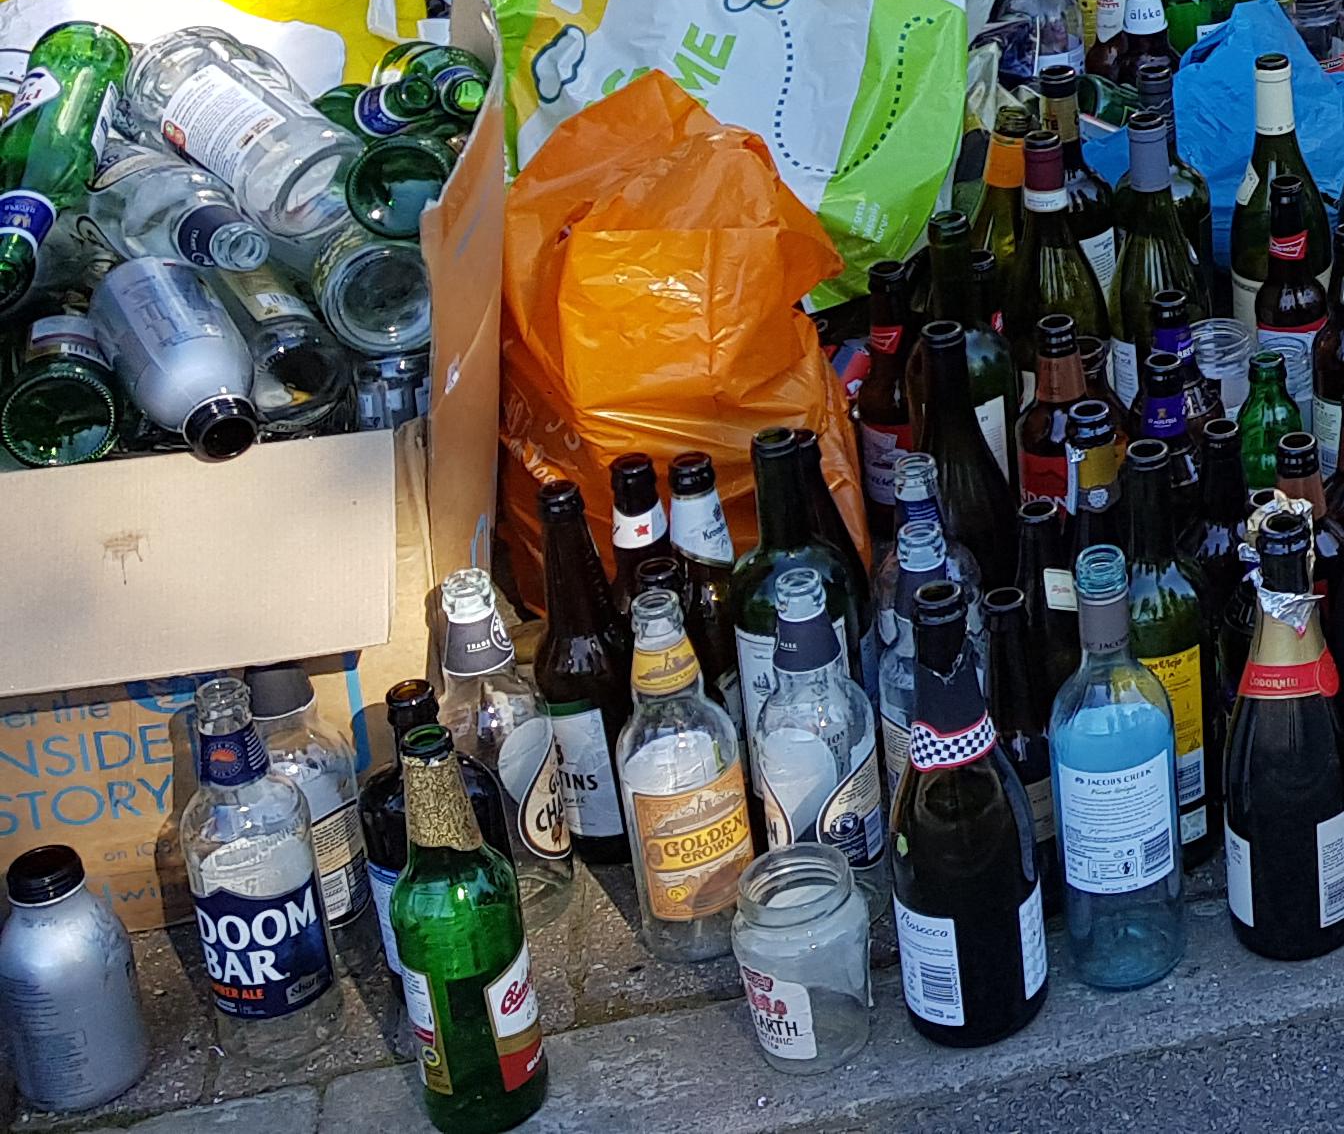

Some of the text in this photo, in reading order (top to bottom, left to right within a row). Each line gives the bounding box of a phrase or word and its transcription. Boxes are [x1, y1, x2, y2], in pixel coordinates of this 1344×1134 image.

[663, 815, 748, 858] GOLDEN
[681, 835, 737, 866] CROWN
[197, 888, 318, 951] DOOM
[204, 948, 284, 986] BAR
[239, 986, 265, 1001] ALE
